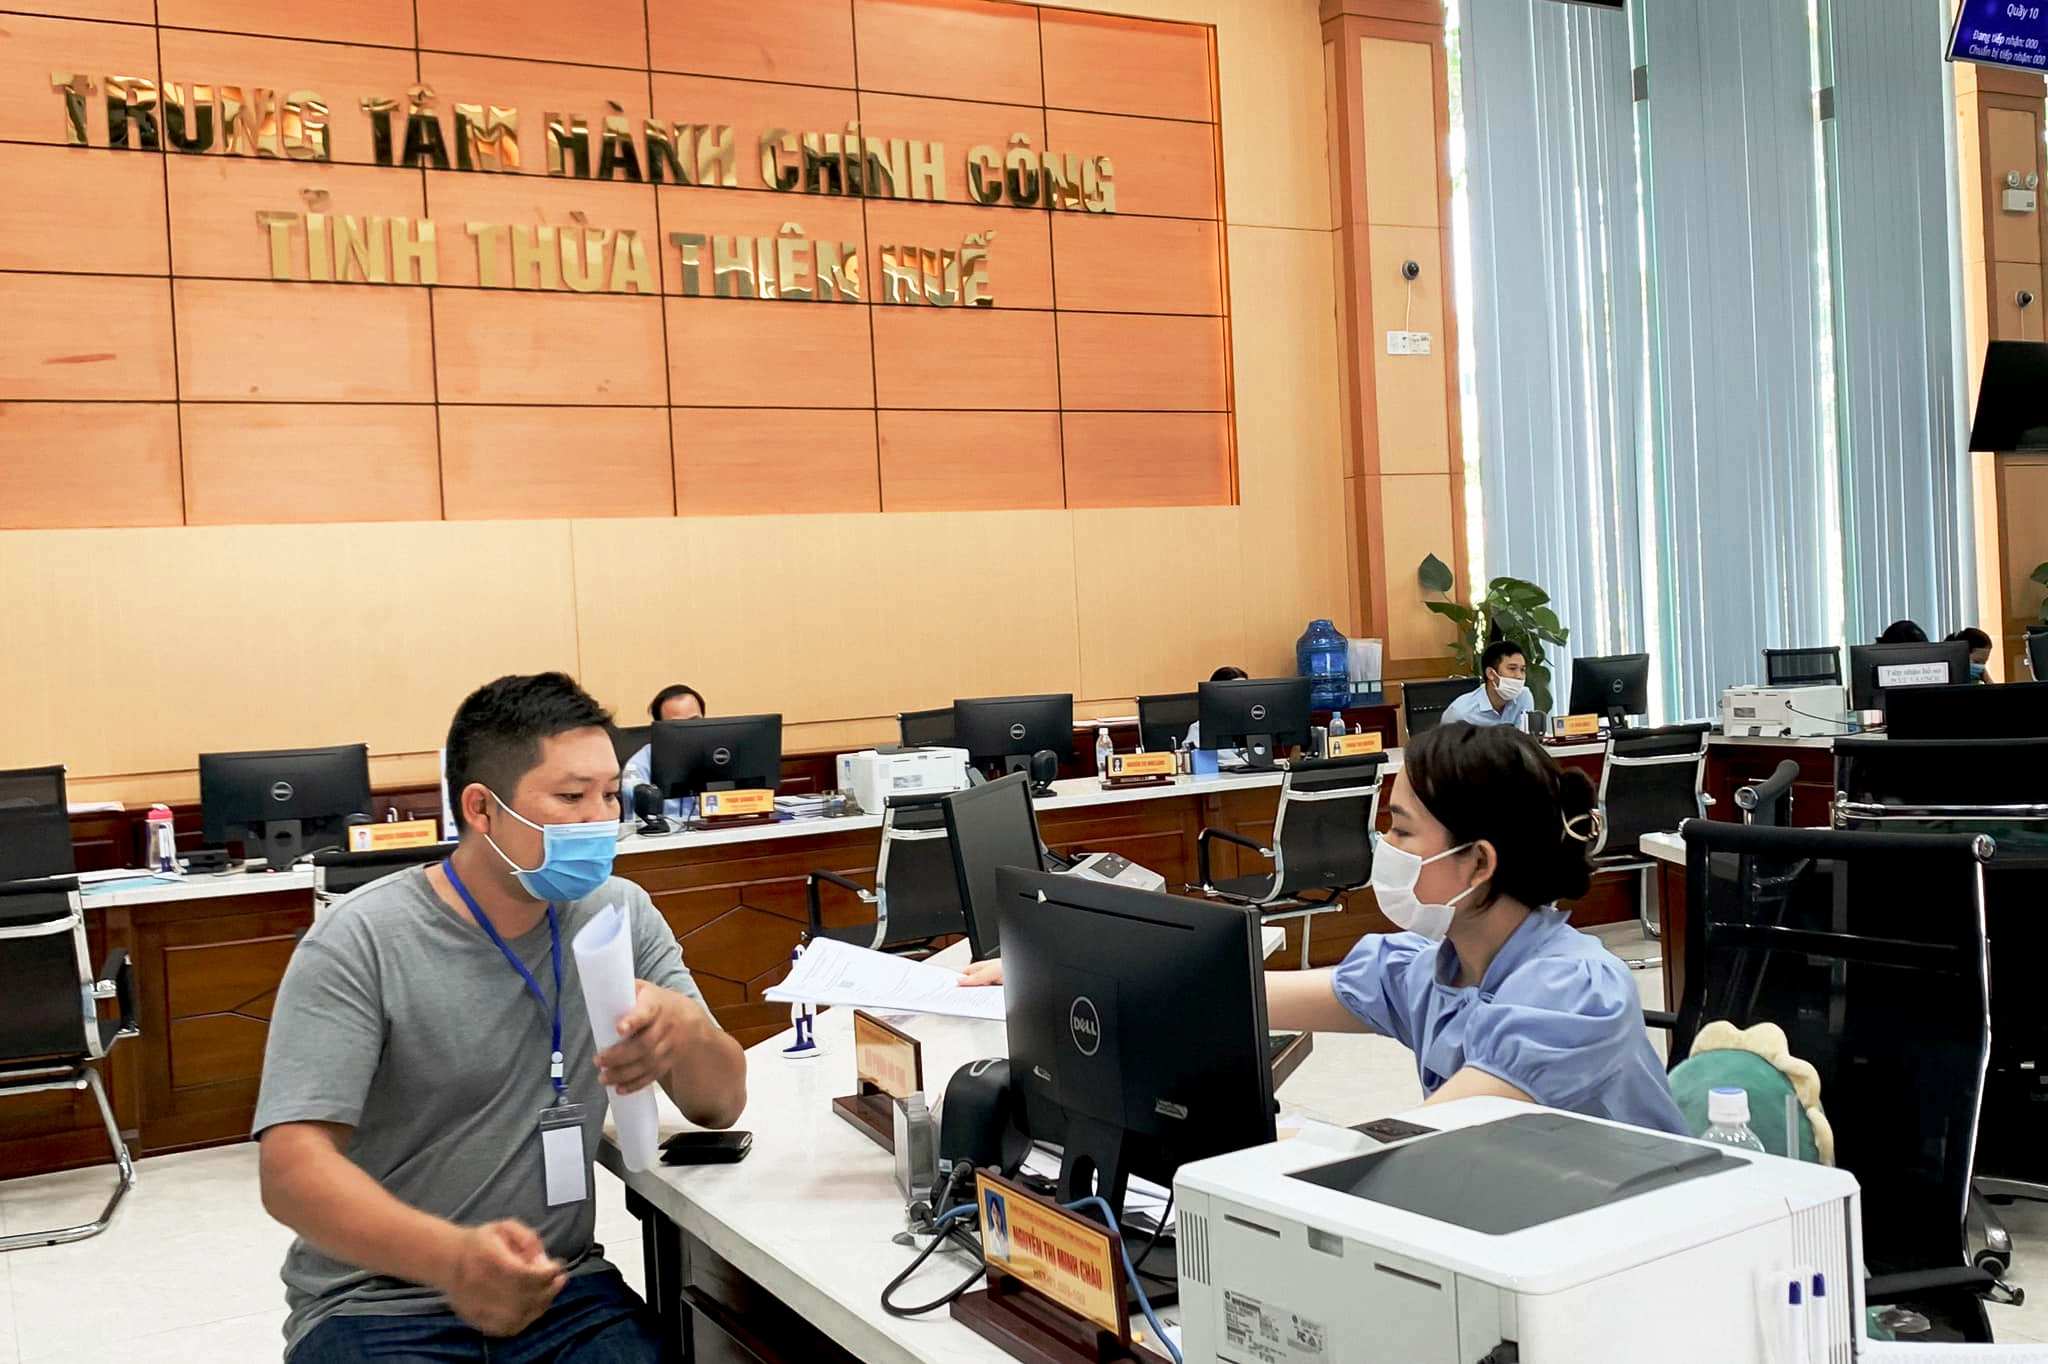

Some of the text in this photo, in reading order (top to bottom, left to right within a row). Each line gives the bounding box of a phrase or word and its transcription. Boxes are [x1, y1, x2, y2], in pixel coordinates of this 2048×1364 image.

[2006, 3, 2039, 20] Quầy 10
[2025, 38, 2039, 49] 000
[2032, 54, 2046, 65] 000
[51, 71, 1116, 213] TRUNG TÂM HÀNH CHÍNH CÔNG
[256, 188, 997, 307] TỈNH THỪA THIÊN HUẾ
[1073, 1016, 1097, 1036] DELL
[1056, 1248, 1079, 1277] MINH
[1080, 1259, 1103, 1290] CHÂU
